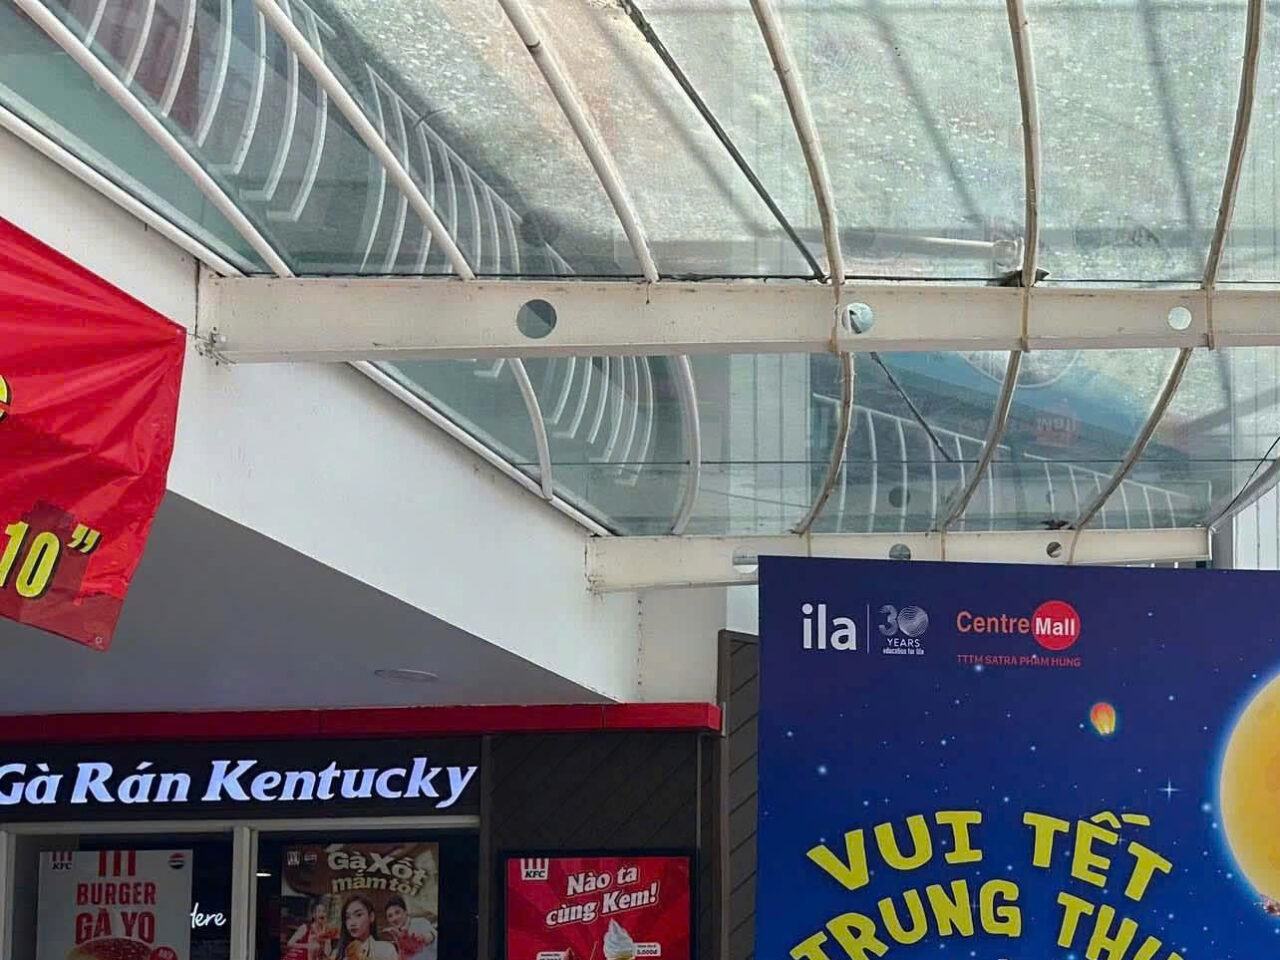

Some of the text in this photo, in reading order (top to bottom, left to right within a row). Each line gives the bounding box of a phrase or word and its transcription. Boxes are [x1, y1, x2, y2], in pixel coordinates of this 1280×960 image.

[802, 603, 857, 651] ila
[956, 611, 1076, 637] Centre Mall
[887, 638, 921, 649] YEARS
[957, 654, 983, 664] TTTM
[984, 656, 1017, 666] SATRA
[0, 757, 478, 809] Gà Rán Kentucky
[52, 862, 72, 870] KFC
[806, 811, 1173, 901] VUI TẾT
[525, 870, 545, 879] KFC
[567, 867, 639, 896] Nào ta
[76, 882, 156, 905] BURGER
[546, 882, 658, 926] cùng Kem!
